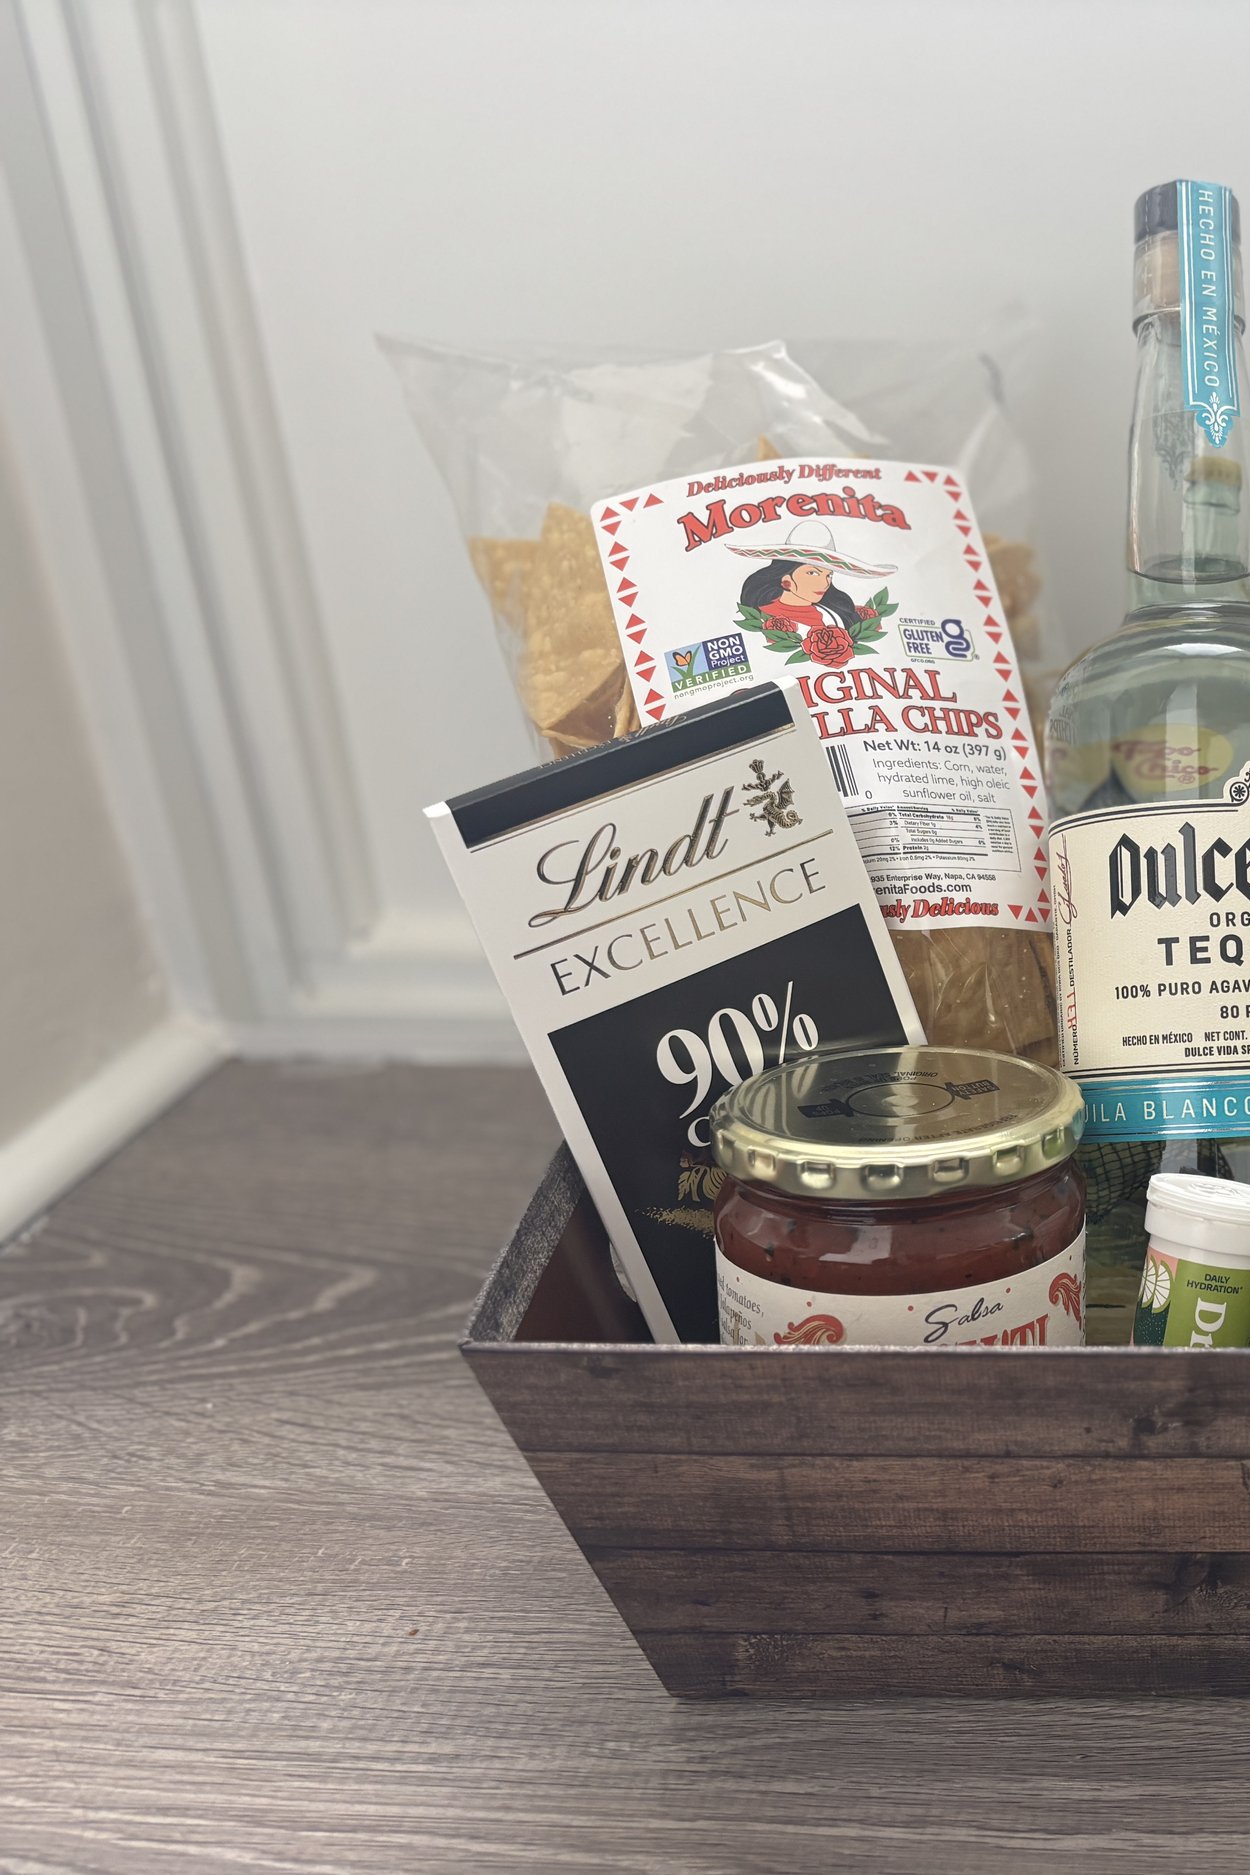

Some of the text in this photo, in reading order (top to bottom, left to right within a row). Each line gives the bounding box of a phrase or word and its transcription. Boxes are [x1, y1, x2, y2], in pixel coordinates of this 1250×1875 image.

[1198, 189, 1221, 388] HECHO EN MÉXICO
[687, 464, 881, 497] Deliciously Different
[677, 486, 912, 552] Morenita
[899, 617, 935, 626] CERTIFIED
[707, 636, 740, 650] NON
[903, 629, 944, 643] GLUTEN
[709, 646, 743, 660] GMO
[907, 642, 932, 655] FREE
[711, 655, 745, 668] Project
[675, 665, 747, 690] VERIFIED
[674, 675, 754, 700] nongmoproject.org
[796, 667, 957, 708] IGINAL
[811, 705, 1003, 740] LLA CHIPS
[863, 739, 1006, 761] Net Wt: 14 oz (397 g)
[873, 758, 1007, 777] Ingredients: Corn, water,
[877, 772, 1011, 790] hydrated lime, high oleic
[903, 787, 996, 804] sunflower oil, salt
[528, 786, 739, 928] Lindt
[886, 873, 923, 883] Enterprise
[924, 873, 943, 882] Way,
[944, 873, 964, 882] Napa,
[873, 883, 972, 896] enitaFoods.com
[912, 897, 999, 920] Delicious
[549, 857, 827, 996] EXCELLENCE
[1066, 928, 1075, 987] DESTILADOR
[1115, 984, 1151, 1000] 100%
[1158, 981, 1202, 996] PURO
[1220, 1005, 1240, 1019] 80
[1122, 1034, 1147, 1047] HECHO
[1149, 1034, 1160, 1045] EN
[1162, 1031, 1193, 1044] MÉXICO
[1204, 1031, 1222, 1042] NET
[1223, 1030, 1248, 1041] CONT.
[656, 980, 819, 1119] 90%
[1184, 1046, 1215, 1057] DULCE
[1216, 1045, 1239, 1056] VIDA
[1204, 1273, 1230, 1284] DAILY
[725, 1283, 764, 1318] tomatoes,
[923, 1297, 1004, 1343] Salsa
